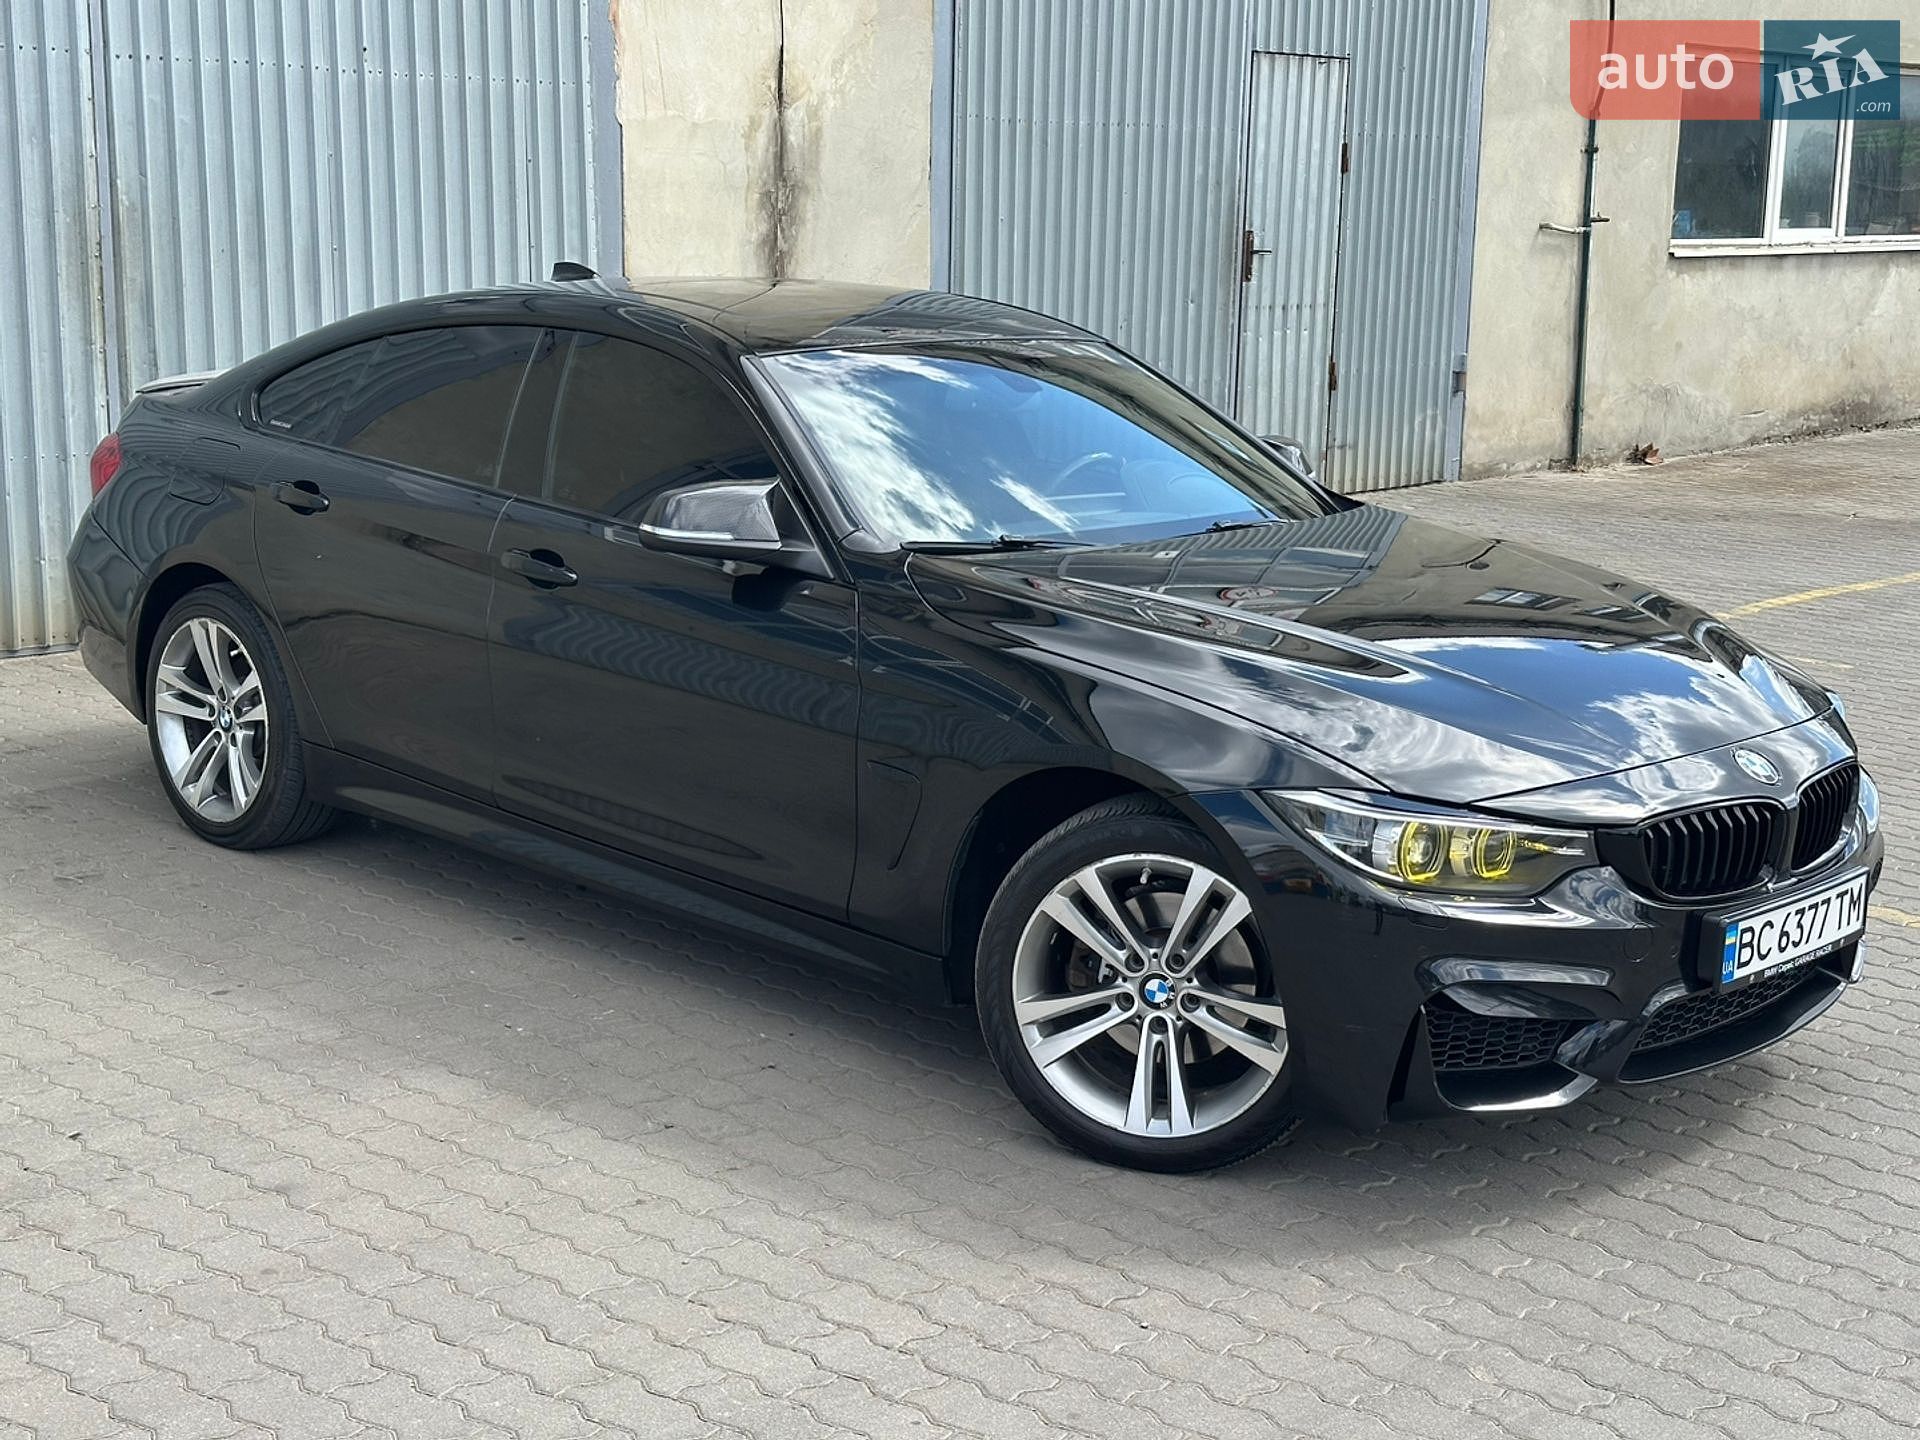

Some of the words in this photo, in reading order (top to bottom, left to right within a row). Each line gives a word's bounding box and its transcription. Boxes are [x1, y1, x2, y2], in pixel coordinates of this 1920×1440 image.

[1737, 920, 1774, 970] BC
[1778, 897, 1831, 953] 6377
[1835, 883, 1863, 930] TM
[1722, 960, 1734, 975] UA
